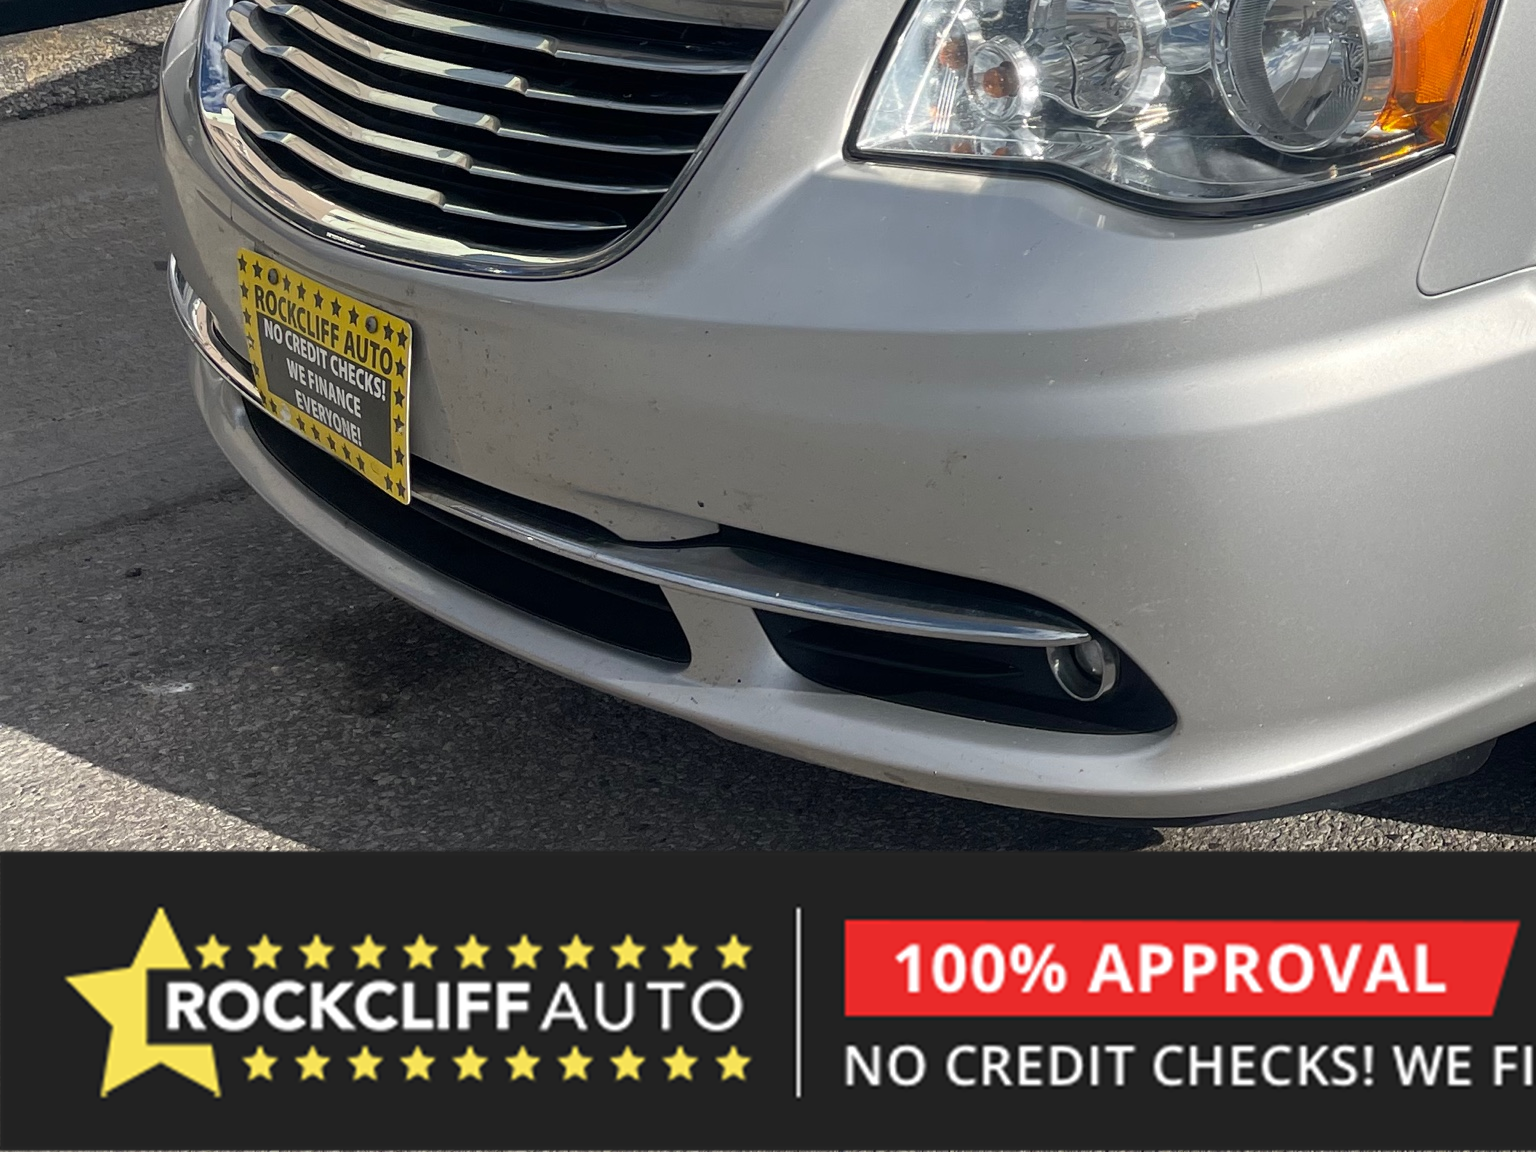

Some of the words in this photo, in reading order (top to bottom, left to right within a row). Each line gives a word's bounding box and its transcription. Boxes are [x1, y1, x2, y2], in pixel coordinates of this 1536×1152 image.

[254, 284, 339, 348] ROCKCLIFF
[343, 331, 393, 375] AUTO
[263, 318, 283, 345] NO
[285, 331, 327, 370] CREDIT
[330, 354, 386, 401] CHECKS!
[286, 358, 307, 387] WE
[308, 369, 361, 418] FINANCE
[295, 389, 362, 447] EVERYONE!
